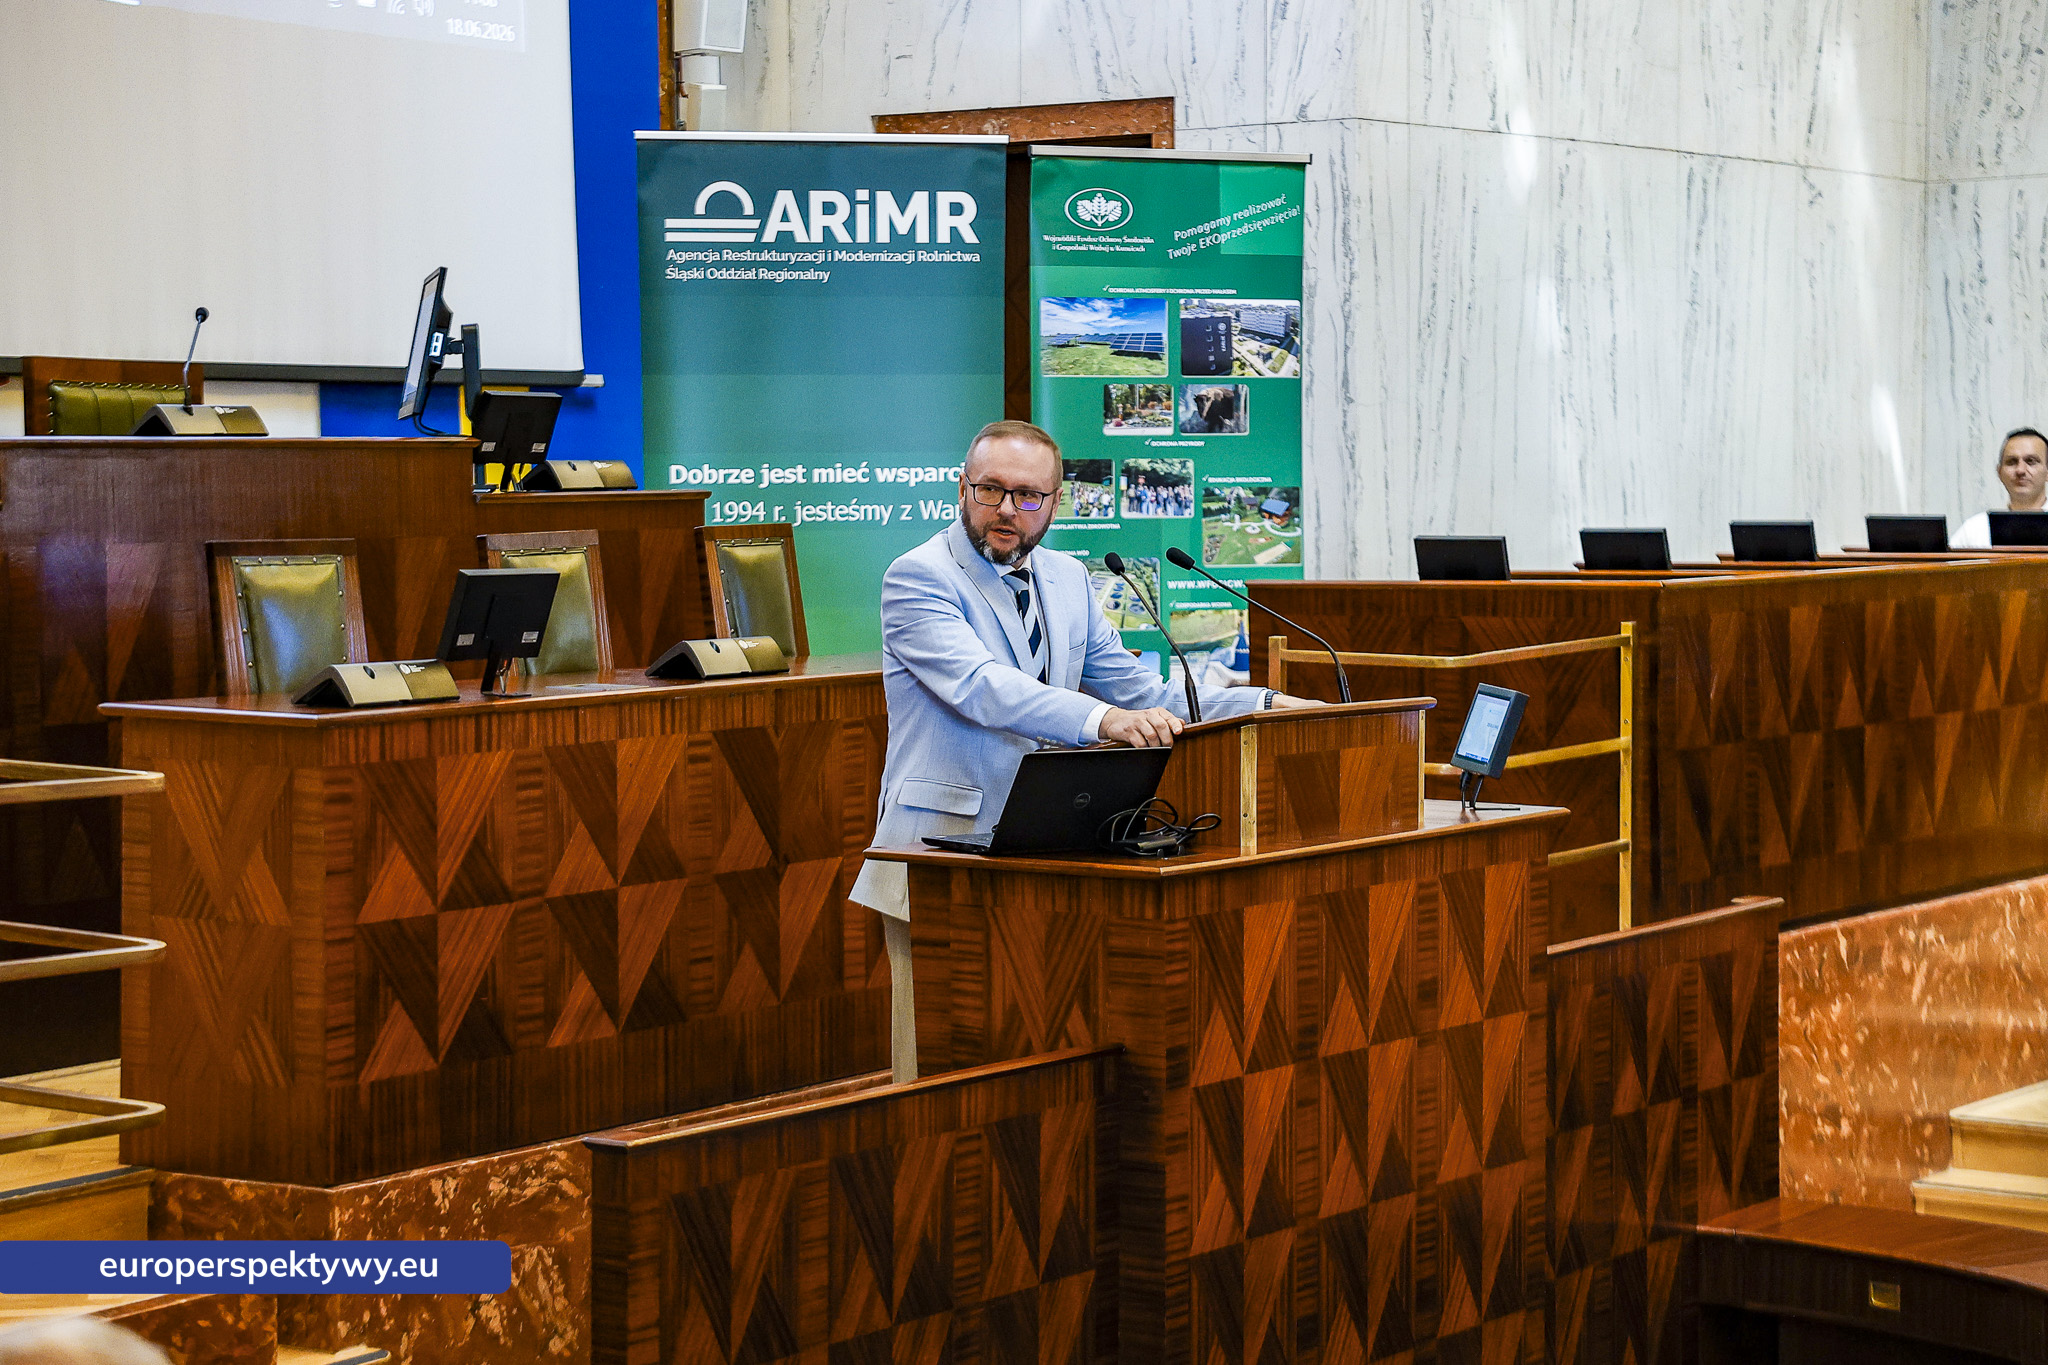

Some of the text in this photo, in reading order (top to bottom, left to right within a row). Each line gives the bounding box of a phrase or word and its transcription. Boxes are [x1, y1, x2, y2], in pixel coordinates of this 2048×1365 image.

[446, 18, 515, 41] 18.06.2026
[761, 189, 981, 243] ARiMR
[1173, 193, 1288, 241] Pomagamy realizować
[1166, 204, 1301, 260] Twoje EKOprzedsięwzięcia!
[666, 249, 981, 265] Agencja Restrukturyzacji i Modernizacji Rolnictwa
[665, 264, 831, 283] Śląski Oddział Regionalny
[669, 463, 755, 485] Dobrze
[758, 463, 807, 488] jest
[812, 462, 869, 484] mieć
[712, 501, 766, 523] 1994
[773, 504, 787, 522] r.
[793, 498, 893, 526] jesteśmy
[899, 504, 913, 521] z
